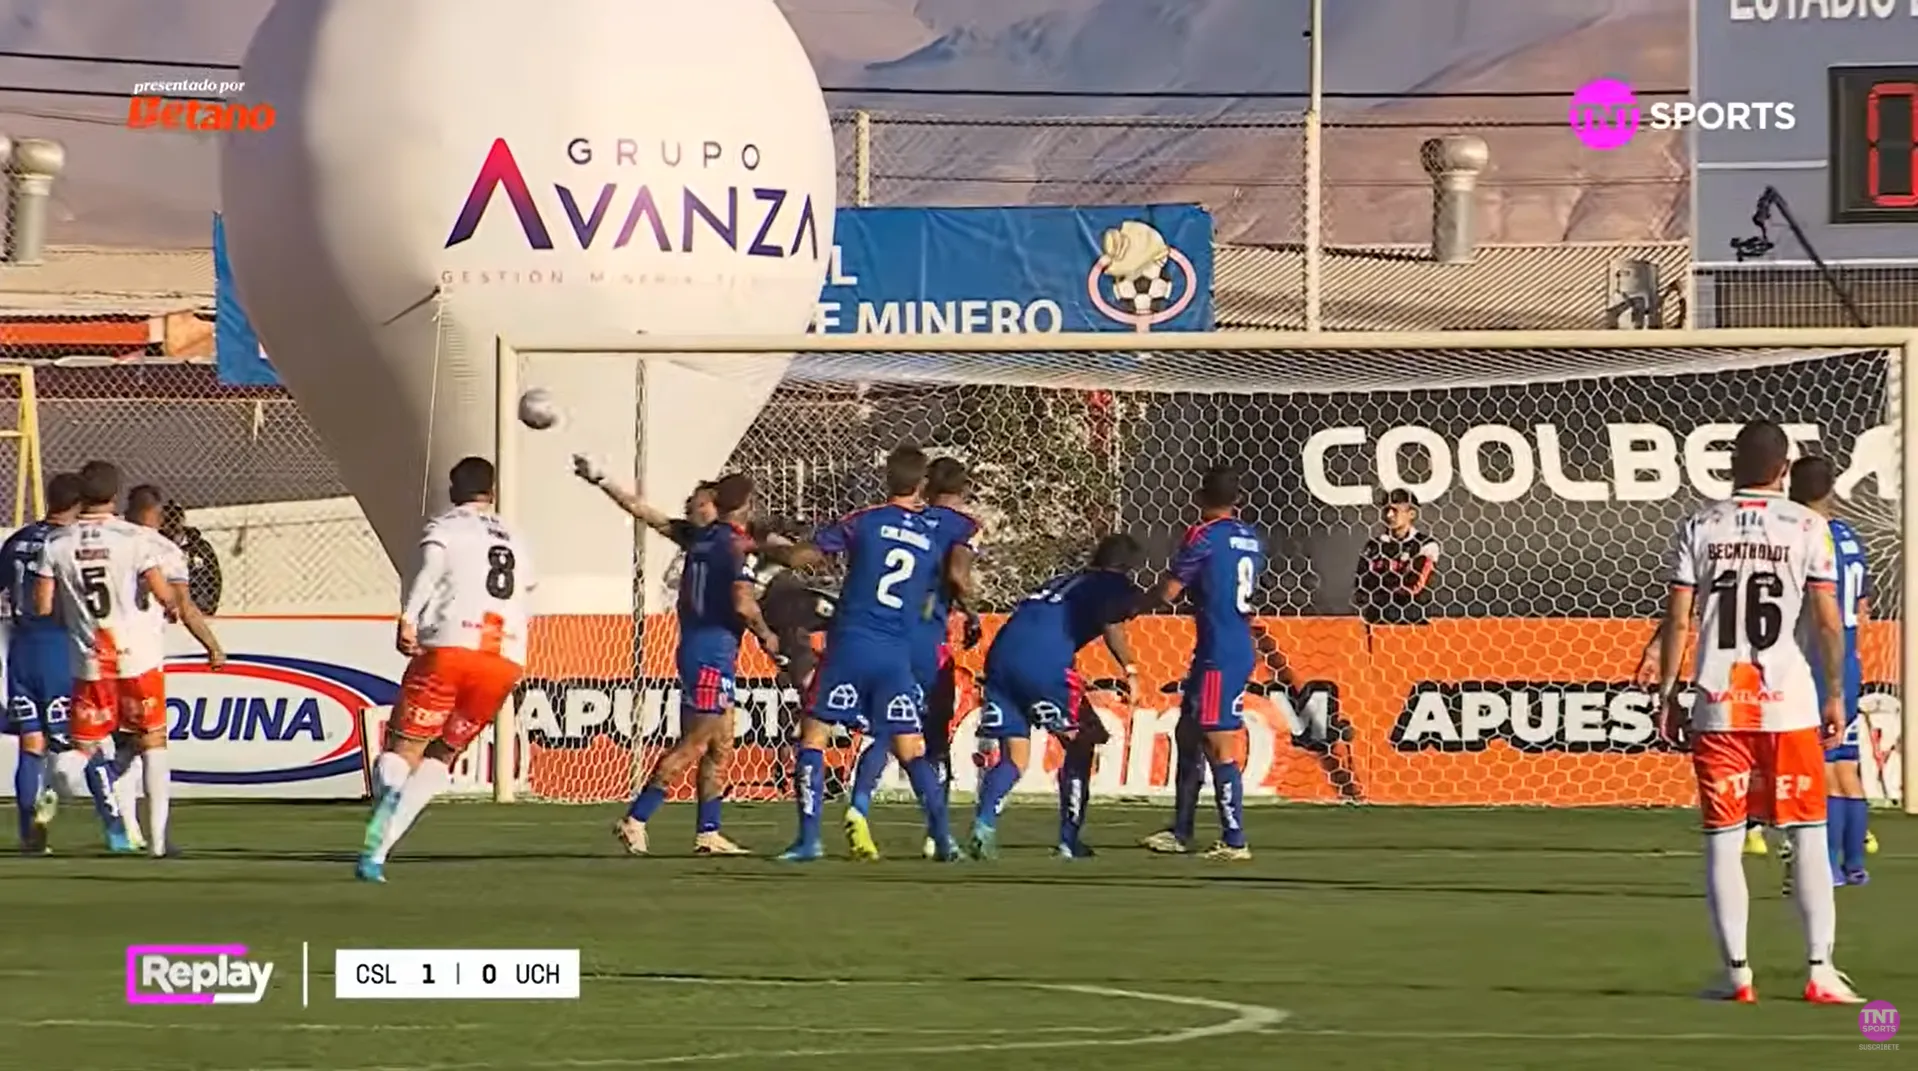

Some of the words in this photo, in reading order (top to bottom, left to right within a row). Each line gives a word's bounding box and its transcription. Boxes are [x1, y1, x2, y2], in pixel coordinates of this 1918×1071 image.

[567, 138, 760, 171] GRUPO
[444, 137, 818, 260] AVANZA
[857, 300, 1063, 334] MINERO
[81, 566, 111, 619] 5
[486, 545, 515, 600] 8
[877, 548, 916, 609] 2
[1711, 570, 1783, 651] 16
[167, 697, 325, 741] QUINA
